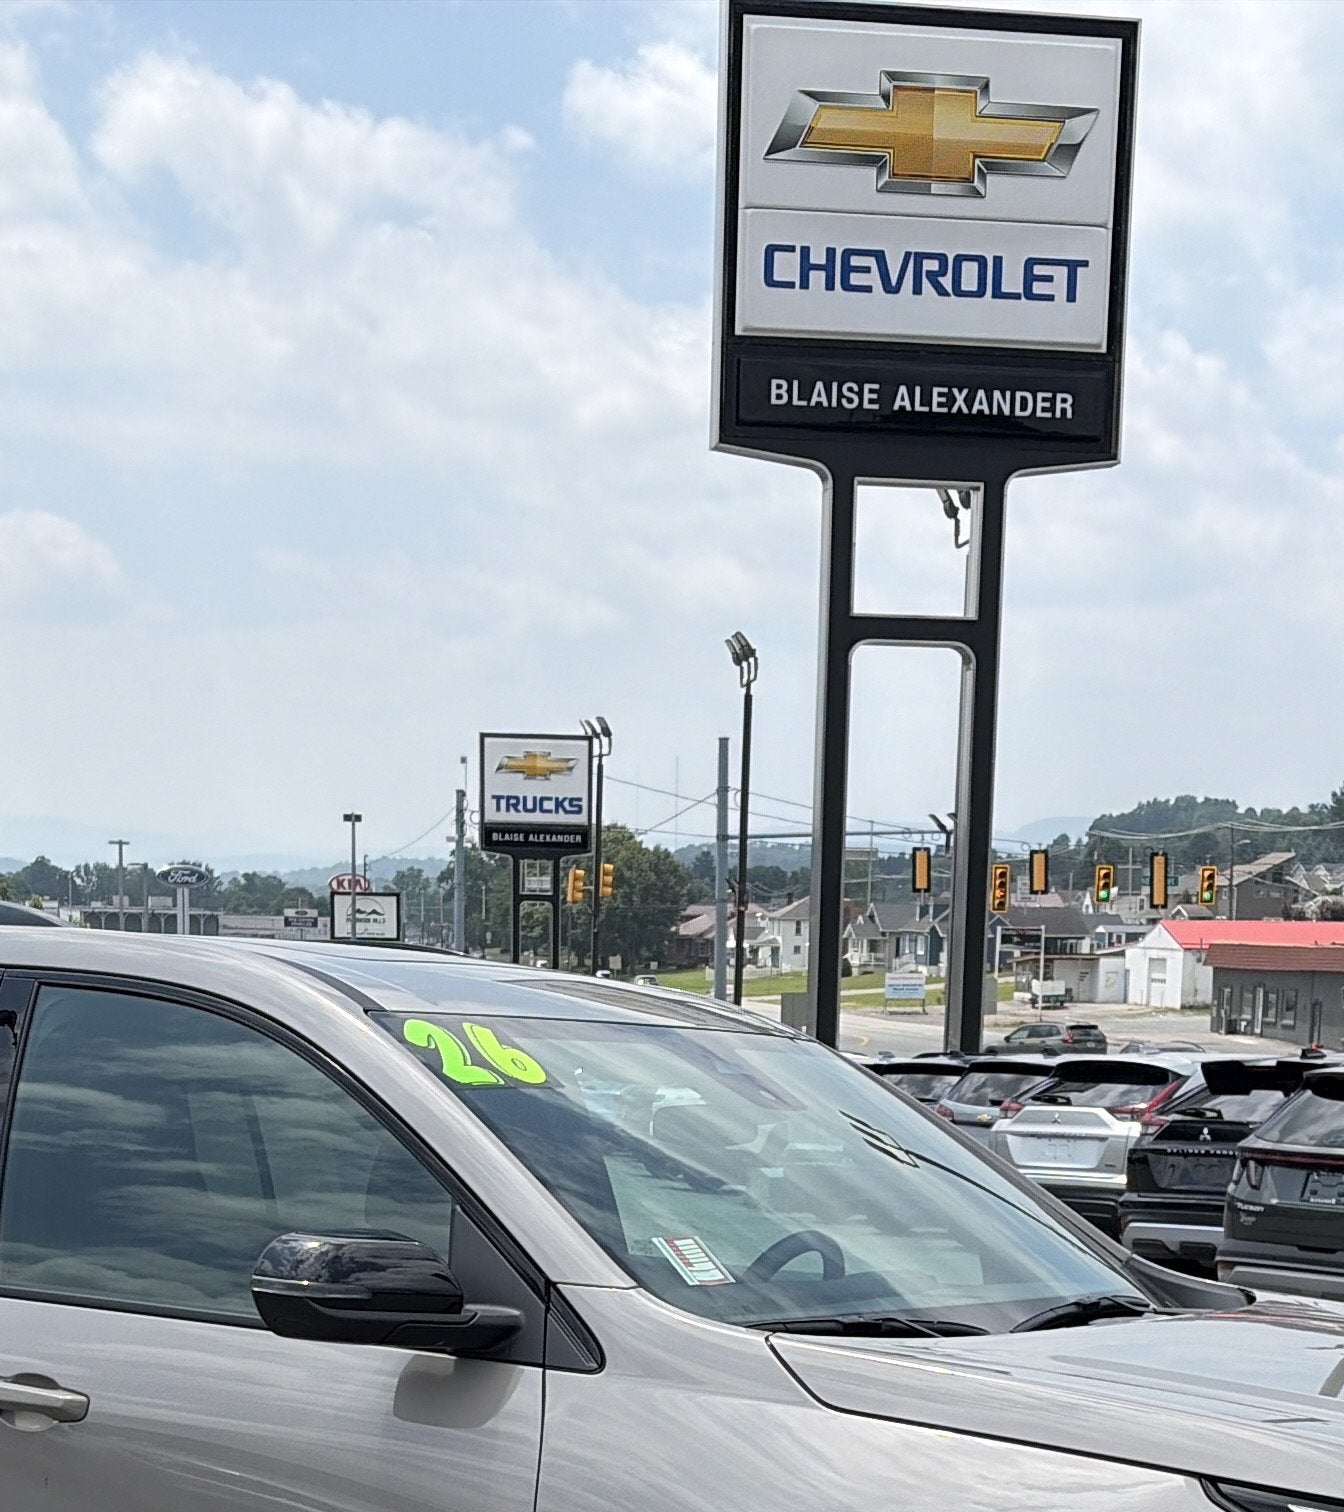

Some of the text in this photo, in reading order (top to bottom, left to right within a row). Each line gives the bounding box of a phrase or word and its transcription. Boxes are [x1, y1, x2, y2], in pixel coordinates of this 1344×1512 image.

[763, 243, 1089, 303] CHEVROLET
[770, 379, 1074, 419] BLAISE ALEXANDER
[491, 795, 583, 815] TRUCKS
[492, 832, 582, 843] BLAISE ALEXANDER
[168, 870, 198, 884] Ford
[403, 1018, 548, 1086] 26
